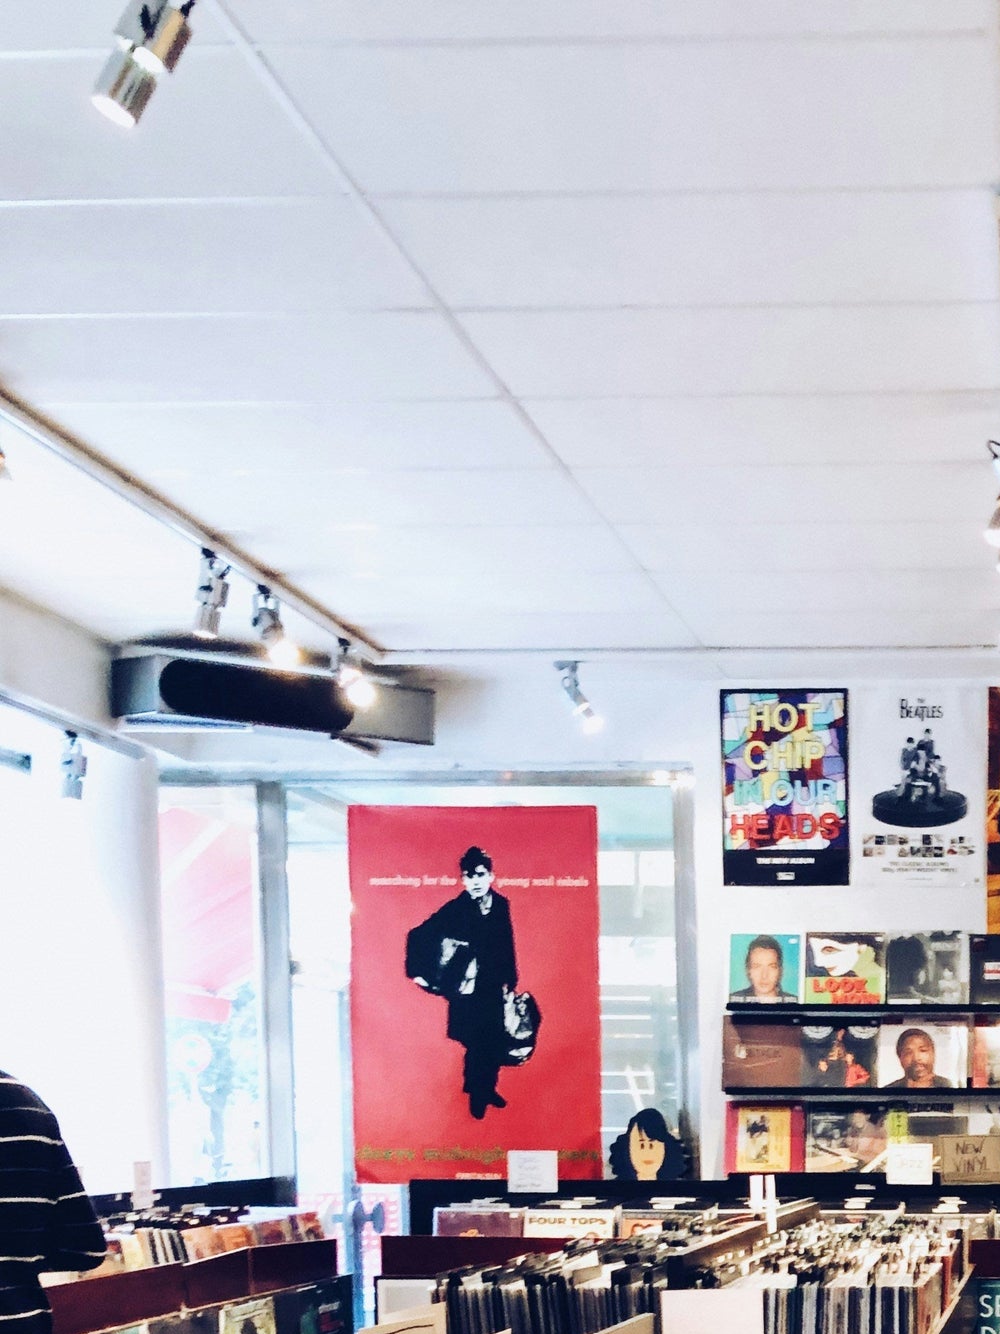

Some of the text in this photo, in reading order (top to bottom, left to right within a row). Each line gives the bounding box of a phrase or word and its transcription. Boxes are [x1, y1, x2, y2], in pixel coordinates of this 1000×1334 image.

[749, 702, 820, 733] HOT
[900, 698, 944, 721] BEATLES
[743, 740, 826, 771] CHIP
[733, 778, 838, 807] IN OUR
[730, 811, 842, 841] HEADS
[813, 978, 868, 993] LOOK
[528, 1216, 607, 1226] FOUR TOPS
